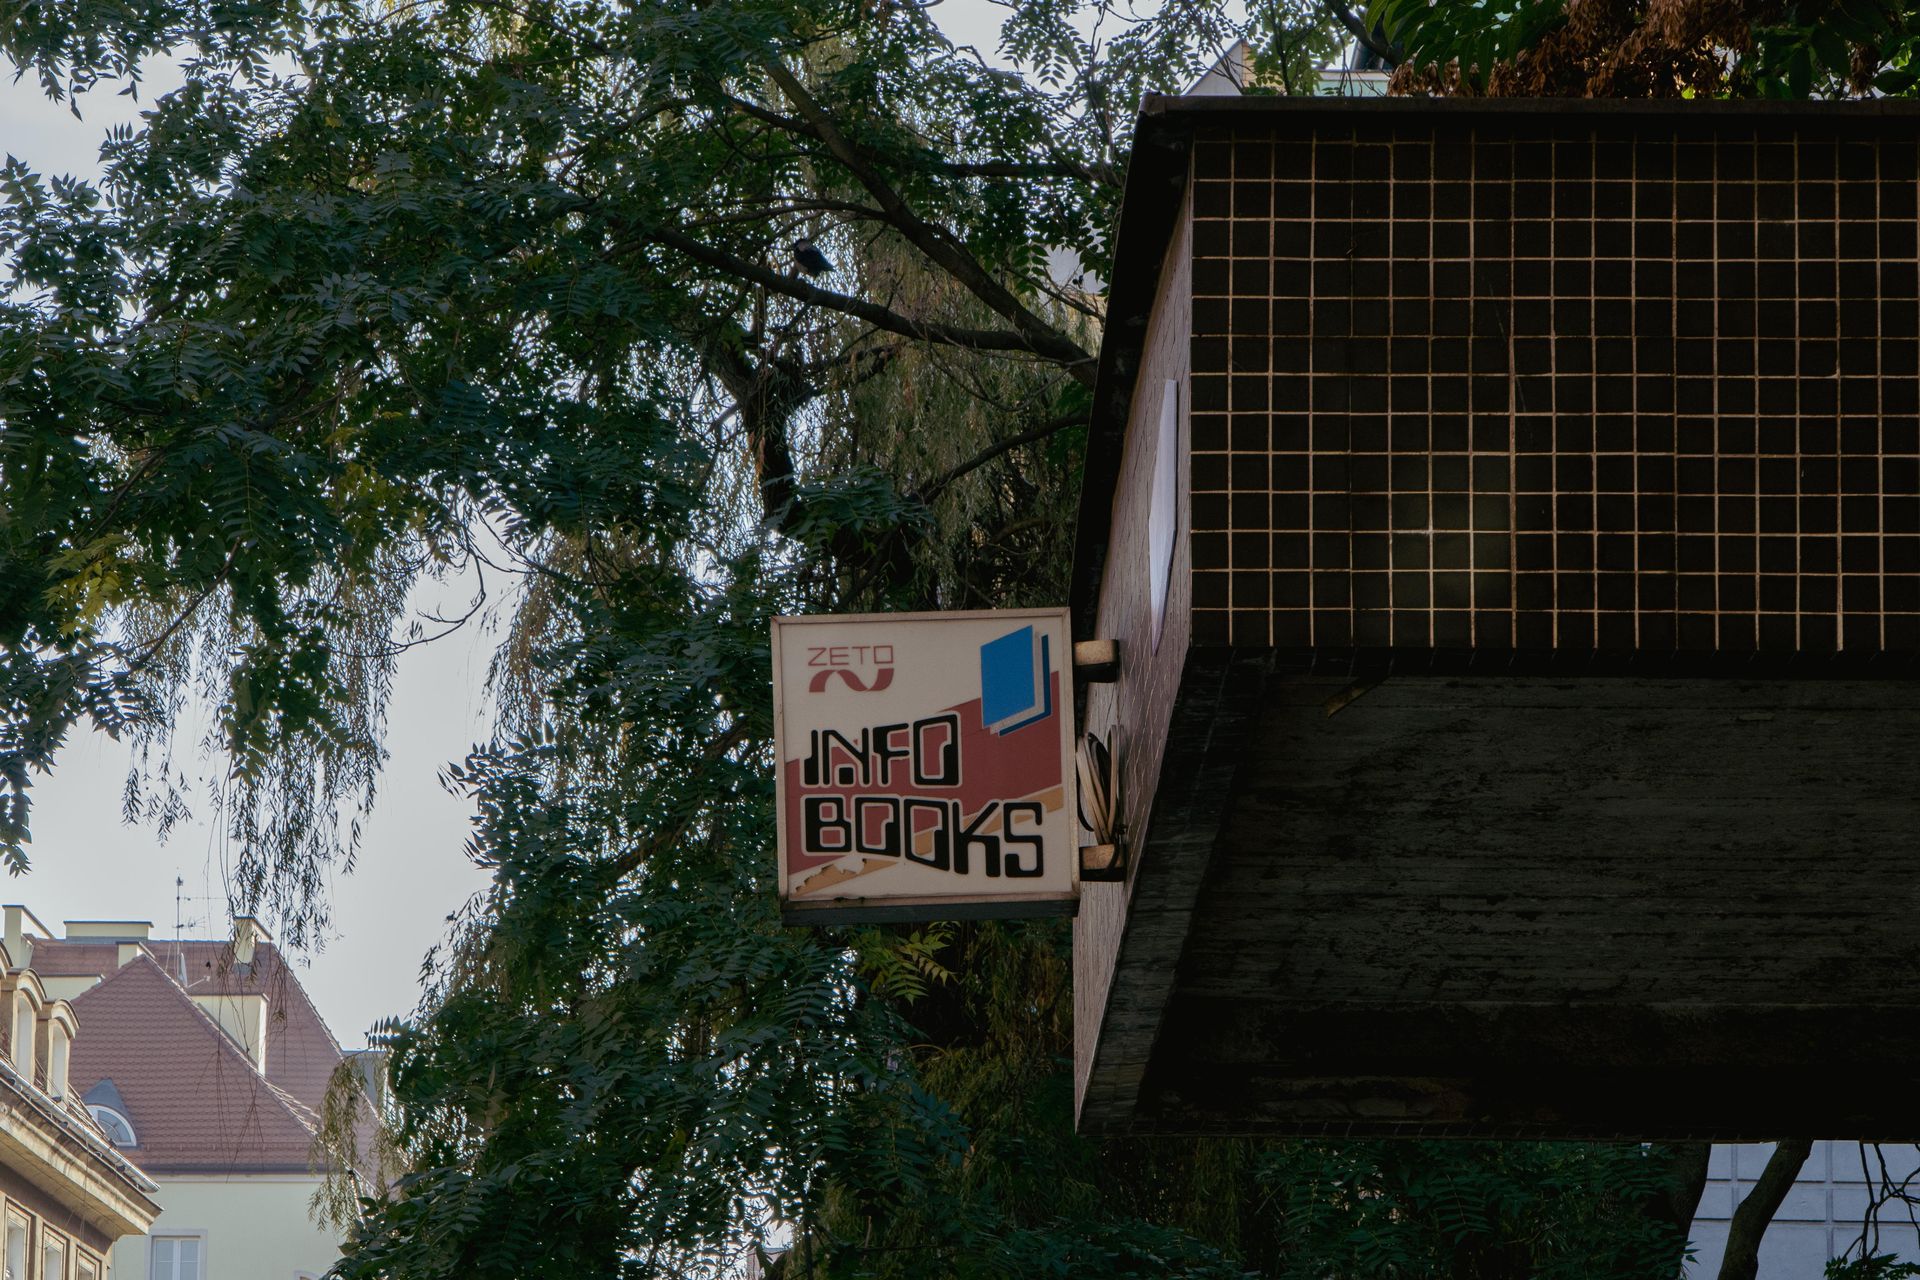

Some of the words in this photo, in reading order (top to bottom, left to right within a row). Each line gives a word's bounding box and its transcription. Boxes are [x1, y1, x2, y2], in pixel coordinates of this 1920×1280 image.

[807, 645, 894, 666] ZETO
[804, 713, 960, 786] INFO
[804, 796, 1044, 878] BOOKS
